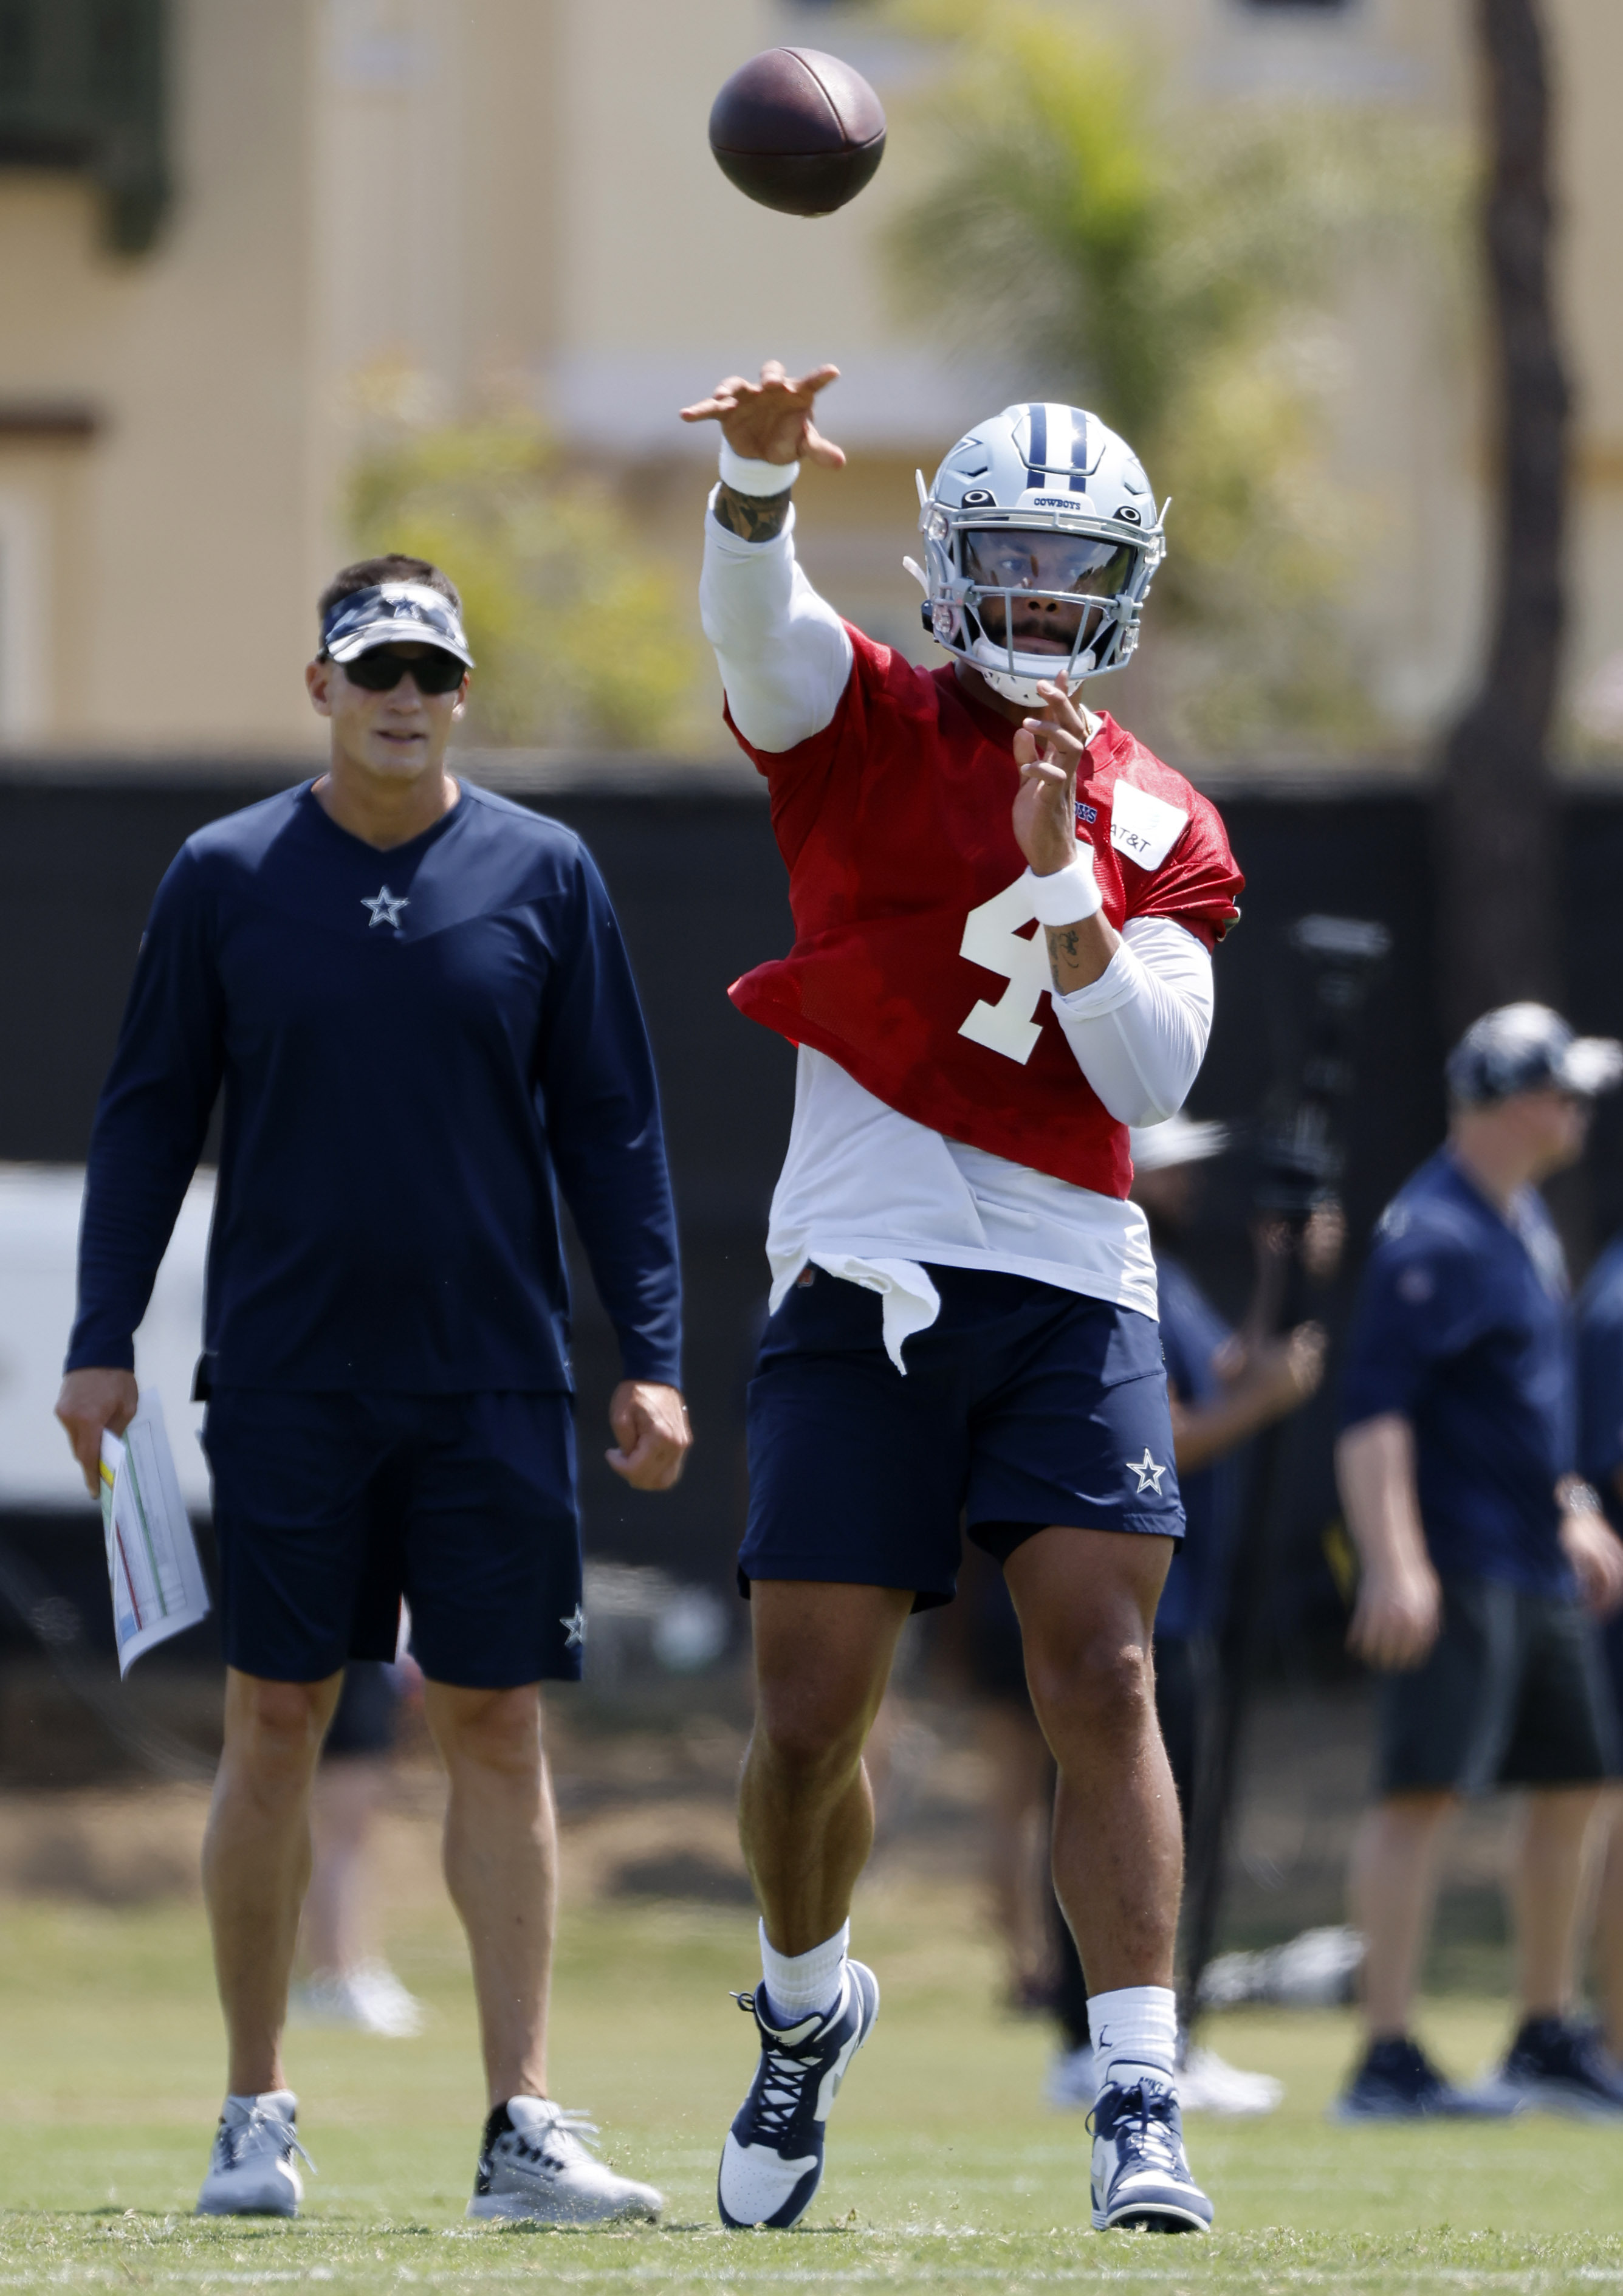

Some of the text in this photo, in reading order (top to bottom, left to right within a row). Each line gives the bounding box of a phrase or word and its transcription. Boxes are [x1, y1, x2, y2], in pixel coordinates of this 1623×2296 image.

[1034, 498, 1081, 510] COWBOYS
[1110, 824, 1151, 853] AT&T
[958, 838, 1094, 1065] 4
